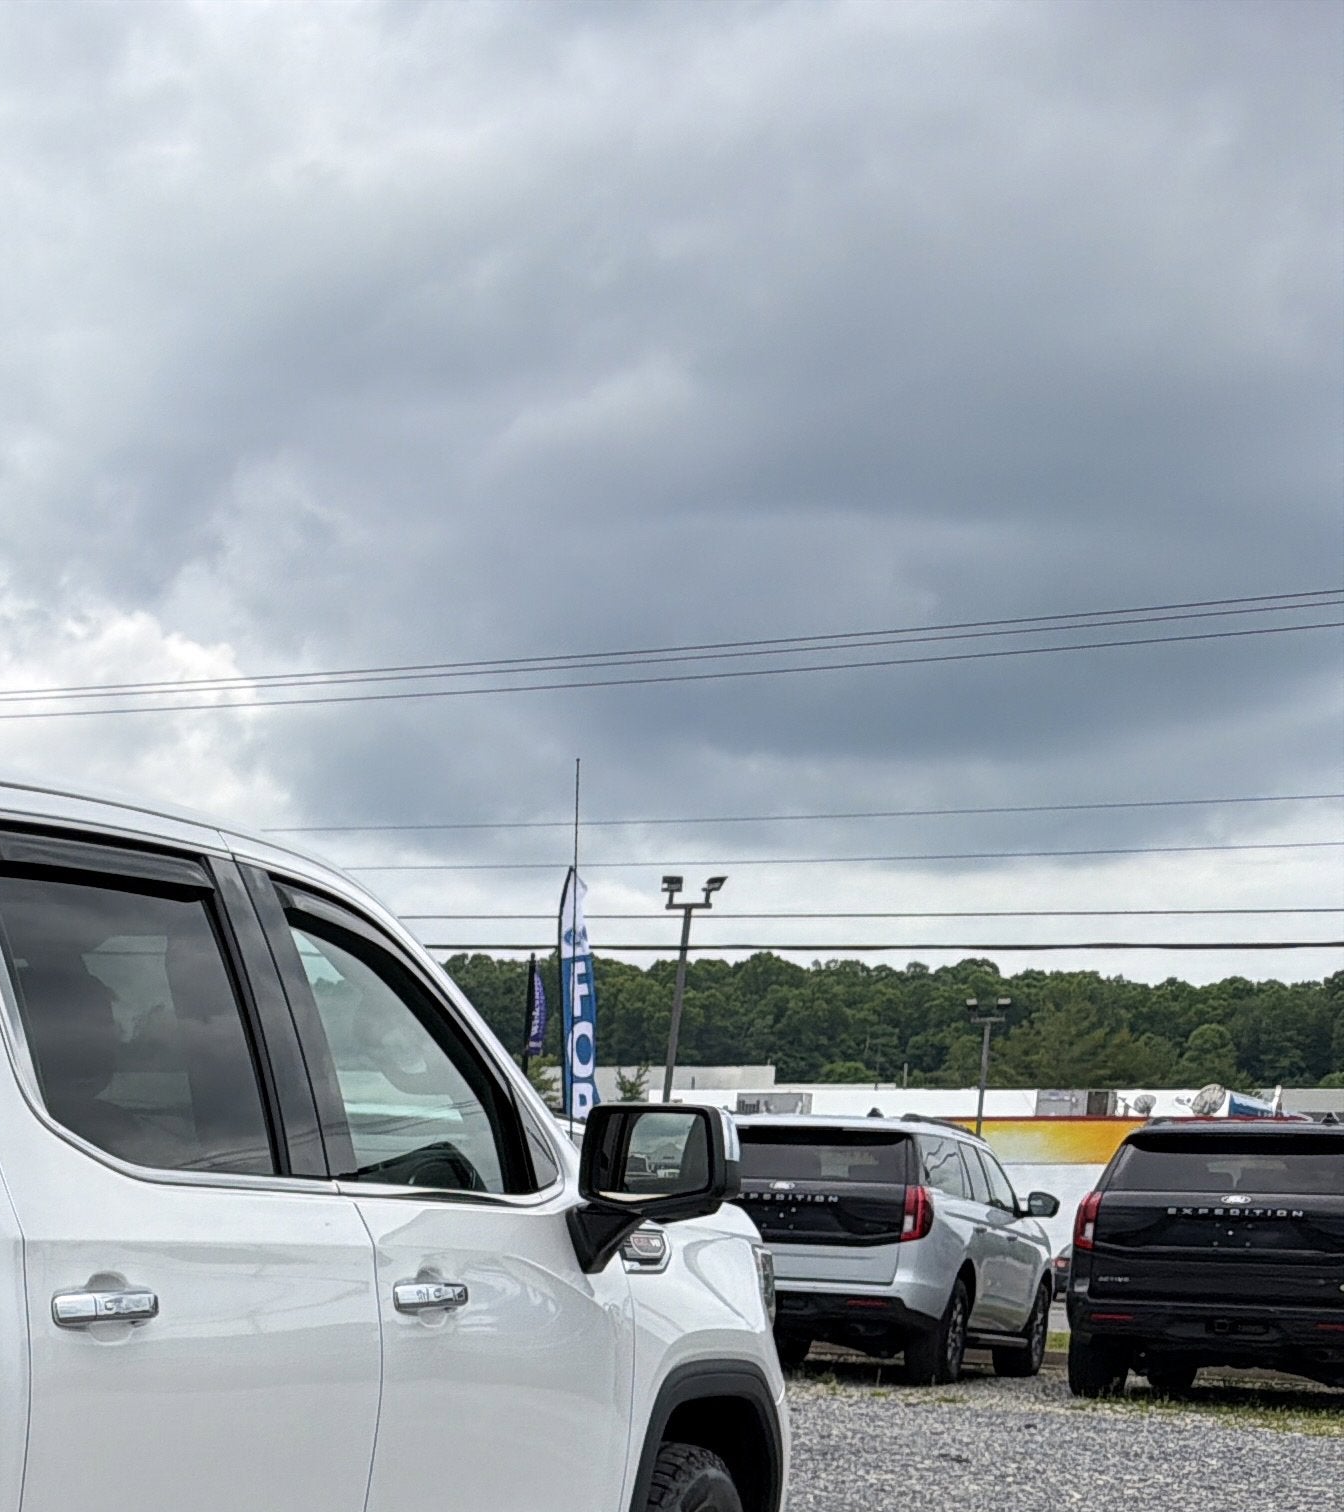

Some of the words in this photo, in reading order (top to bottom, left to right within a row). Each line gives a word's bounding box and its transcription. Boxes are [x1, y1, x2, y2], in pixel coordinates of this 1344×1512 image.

[567, 960, 593, 1125] FOR
[736, 1192, 838, 1203] XPEDITION
[1167, 1207, 1304, 1218] EXPEDITION
